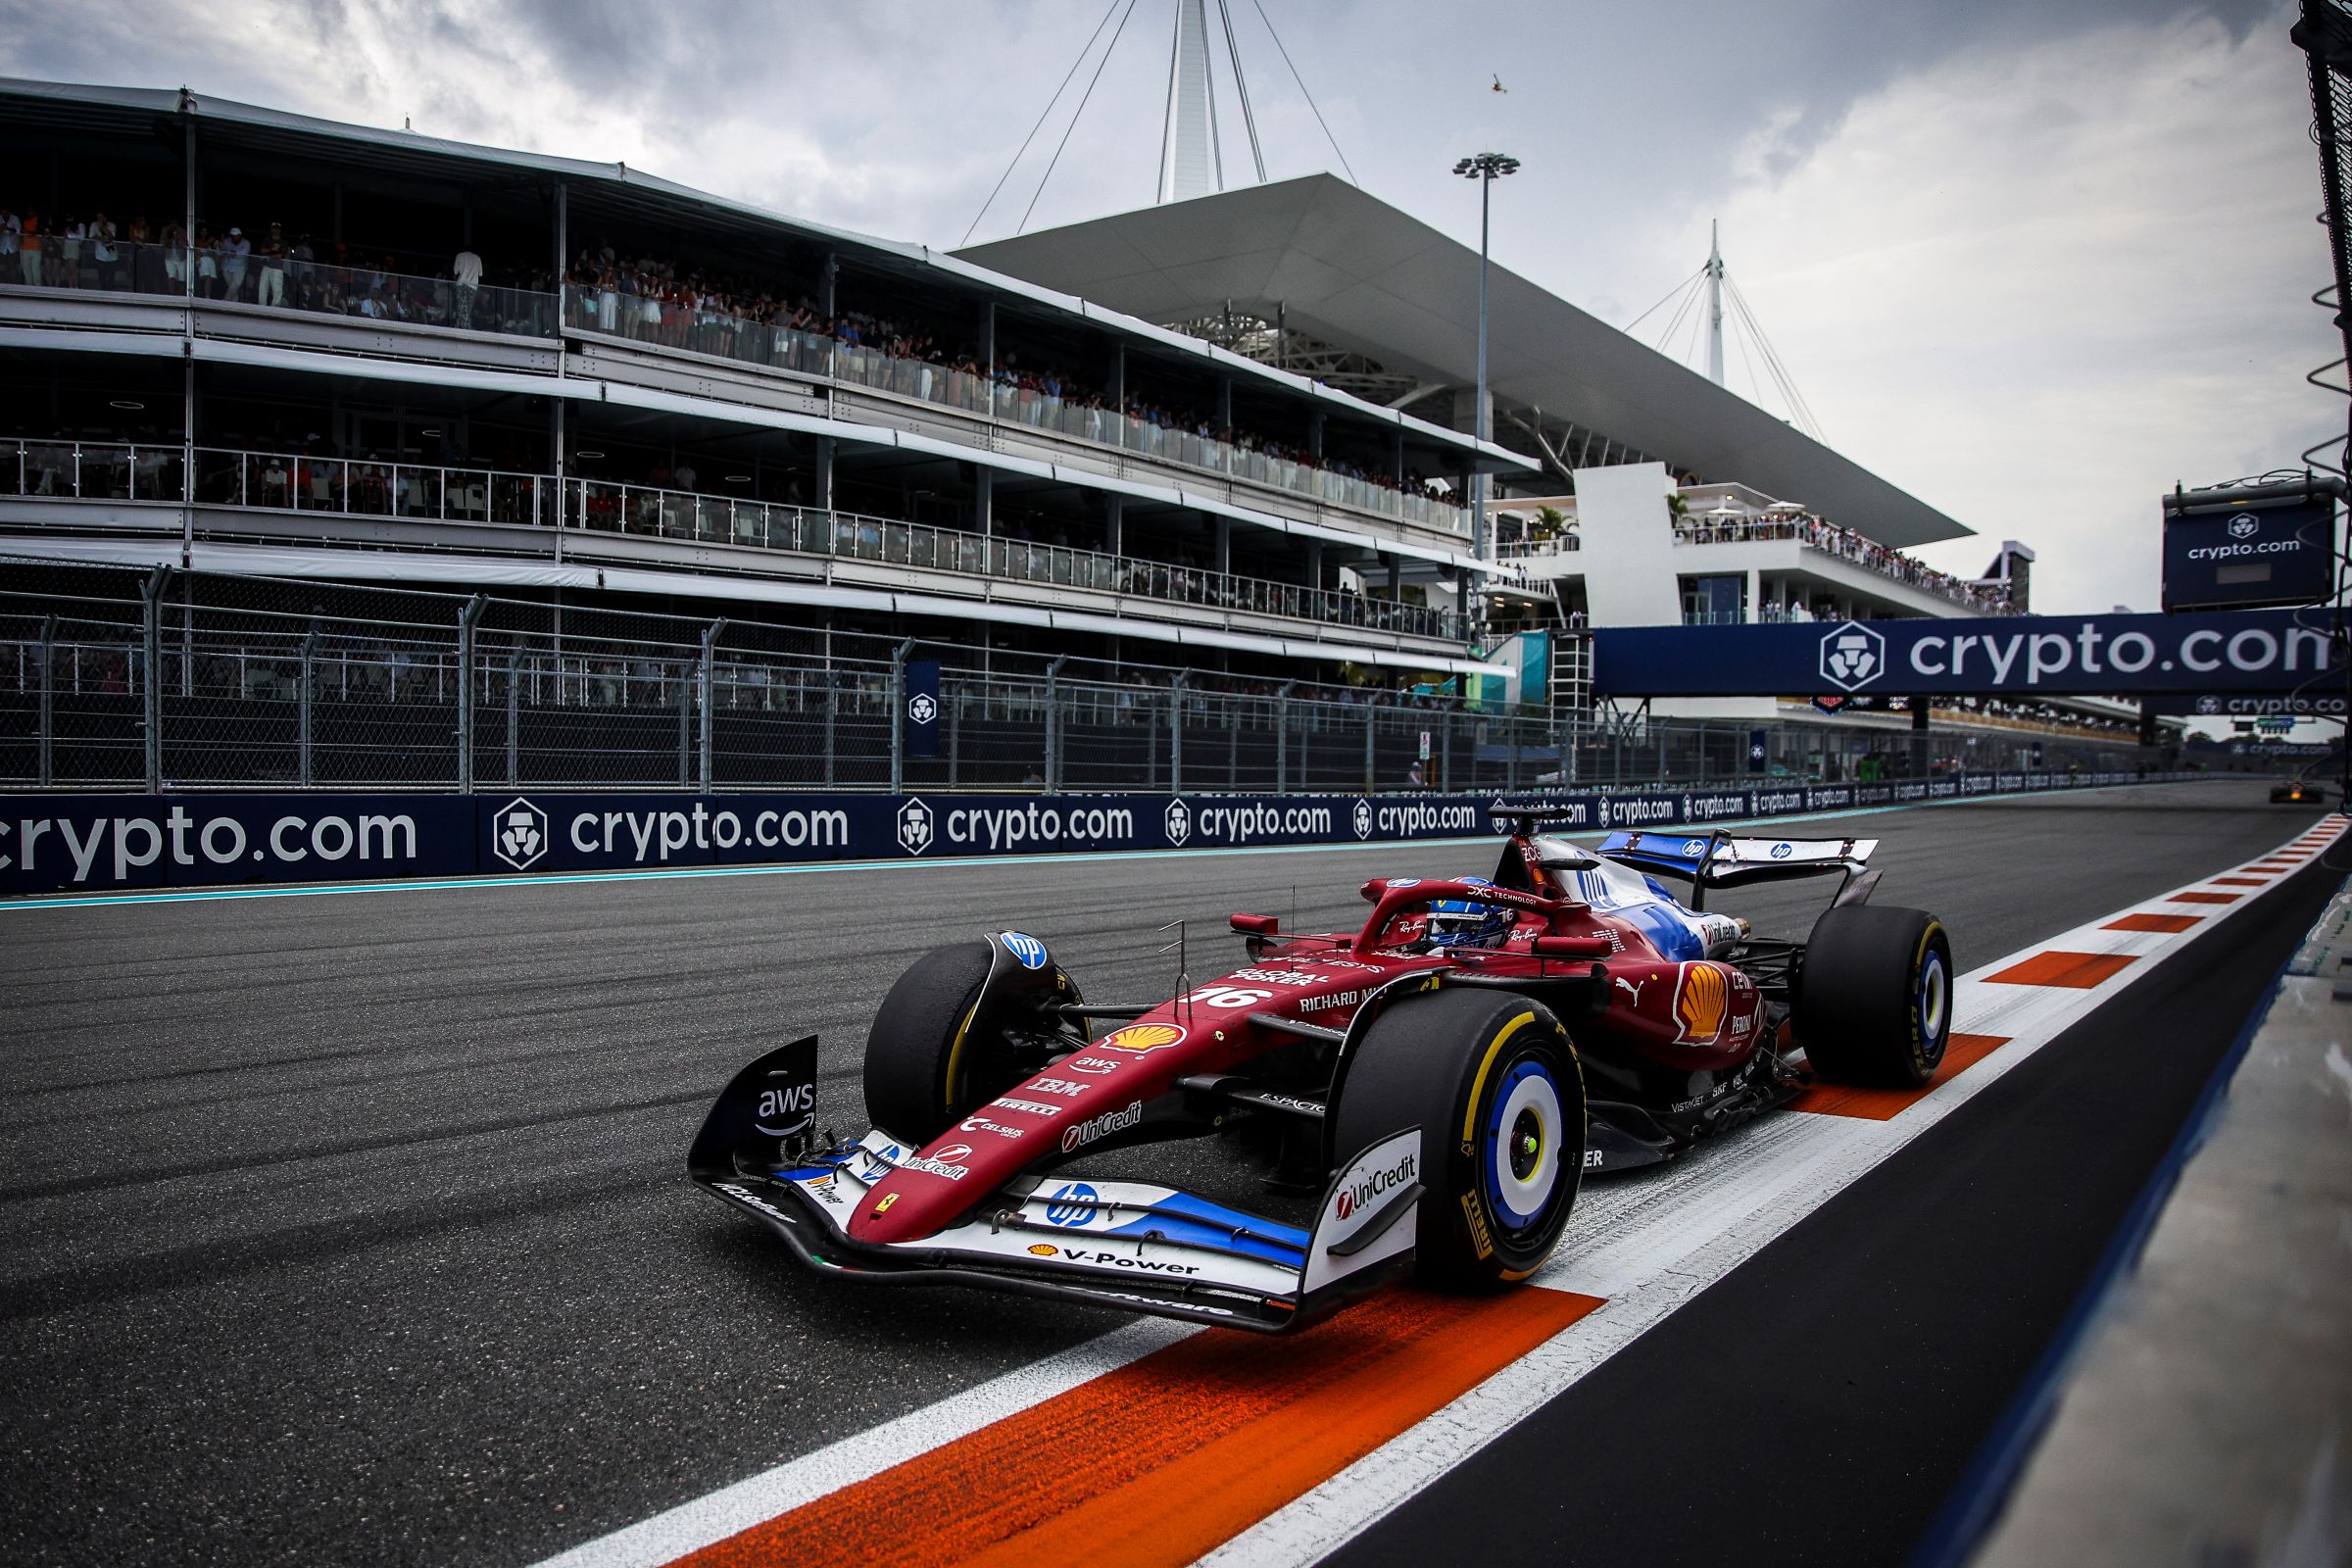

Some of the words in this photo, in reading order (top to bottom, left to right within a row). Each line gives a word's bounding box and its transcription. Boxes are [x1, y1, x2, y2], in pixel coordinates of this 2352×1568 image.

[2187, 540, 2301, 560] crypto.com
[2228, 695, 2345, 713] crypto.co
[1613, 795, 1674, 824] crypto.com
[1694, 792, 1744, 816] crypto.com
[1760, 790, 1801, 811] crypto.com
[570, 802, 849, 860] crypto.com
[947, 802, 1133, 850] crypto.com
[1200, 802, 1332, 841] crypto.com
[1378, 800, 1476, 839] crypto.com
[1681, 839, 1706, 858] hp
[1770, 843, 1792, 859] hp
[1467, 885, 1493, 899] DXC
[1494, 892, 1537, 906] TECHNOLOGY
[1000, 932, 1048, 969] hp
[1227, 972, 1318, 987] POKER
[1235, 968, 1331, 983] GLOBAL
[1177, 985, 1274, 1008] 16
[1299, 991, 1358, 1013] RICHARD
[1075, 1056, 1122, 1071] aws
[1026, 1077, 1092, 1097] IBM
[1712, 1081, 1728, 1098] SKF
[758, 1083, 814, 1118] aws
[989, 1097, 1063, 1116] PIRELLI
[980, 1122, 1025, 1138] CELSIUS
[1077, 1100, 1143, 1147] UniCredit
[901, 1156, 970, 1181] UniCredit
[1352, 1152, 1416, 1209] UniCredit
[1047, 1182, 1099, 1227] hp
[1460, 1188, 1494, 1261] PIRELLI
[1063, 1249, 1200, 1274] V-Power
